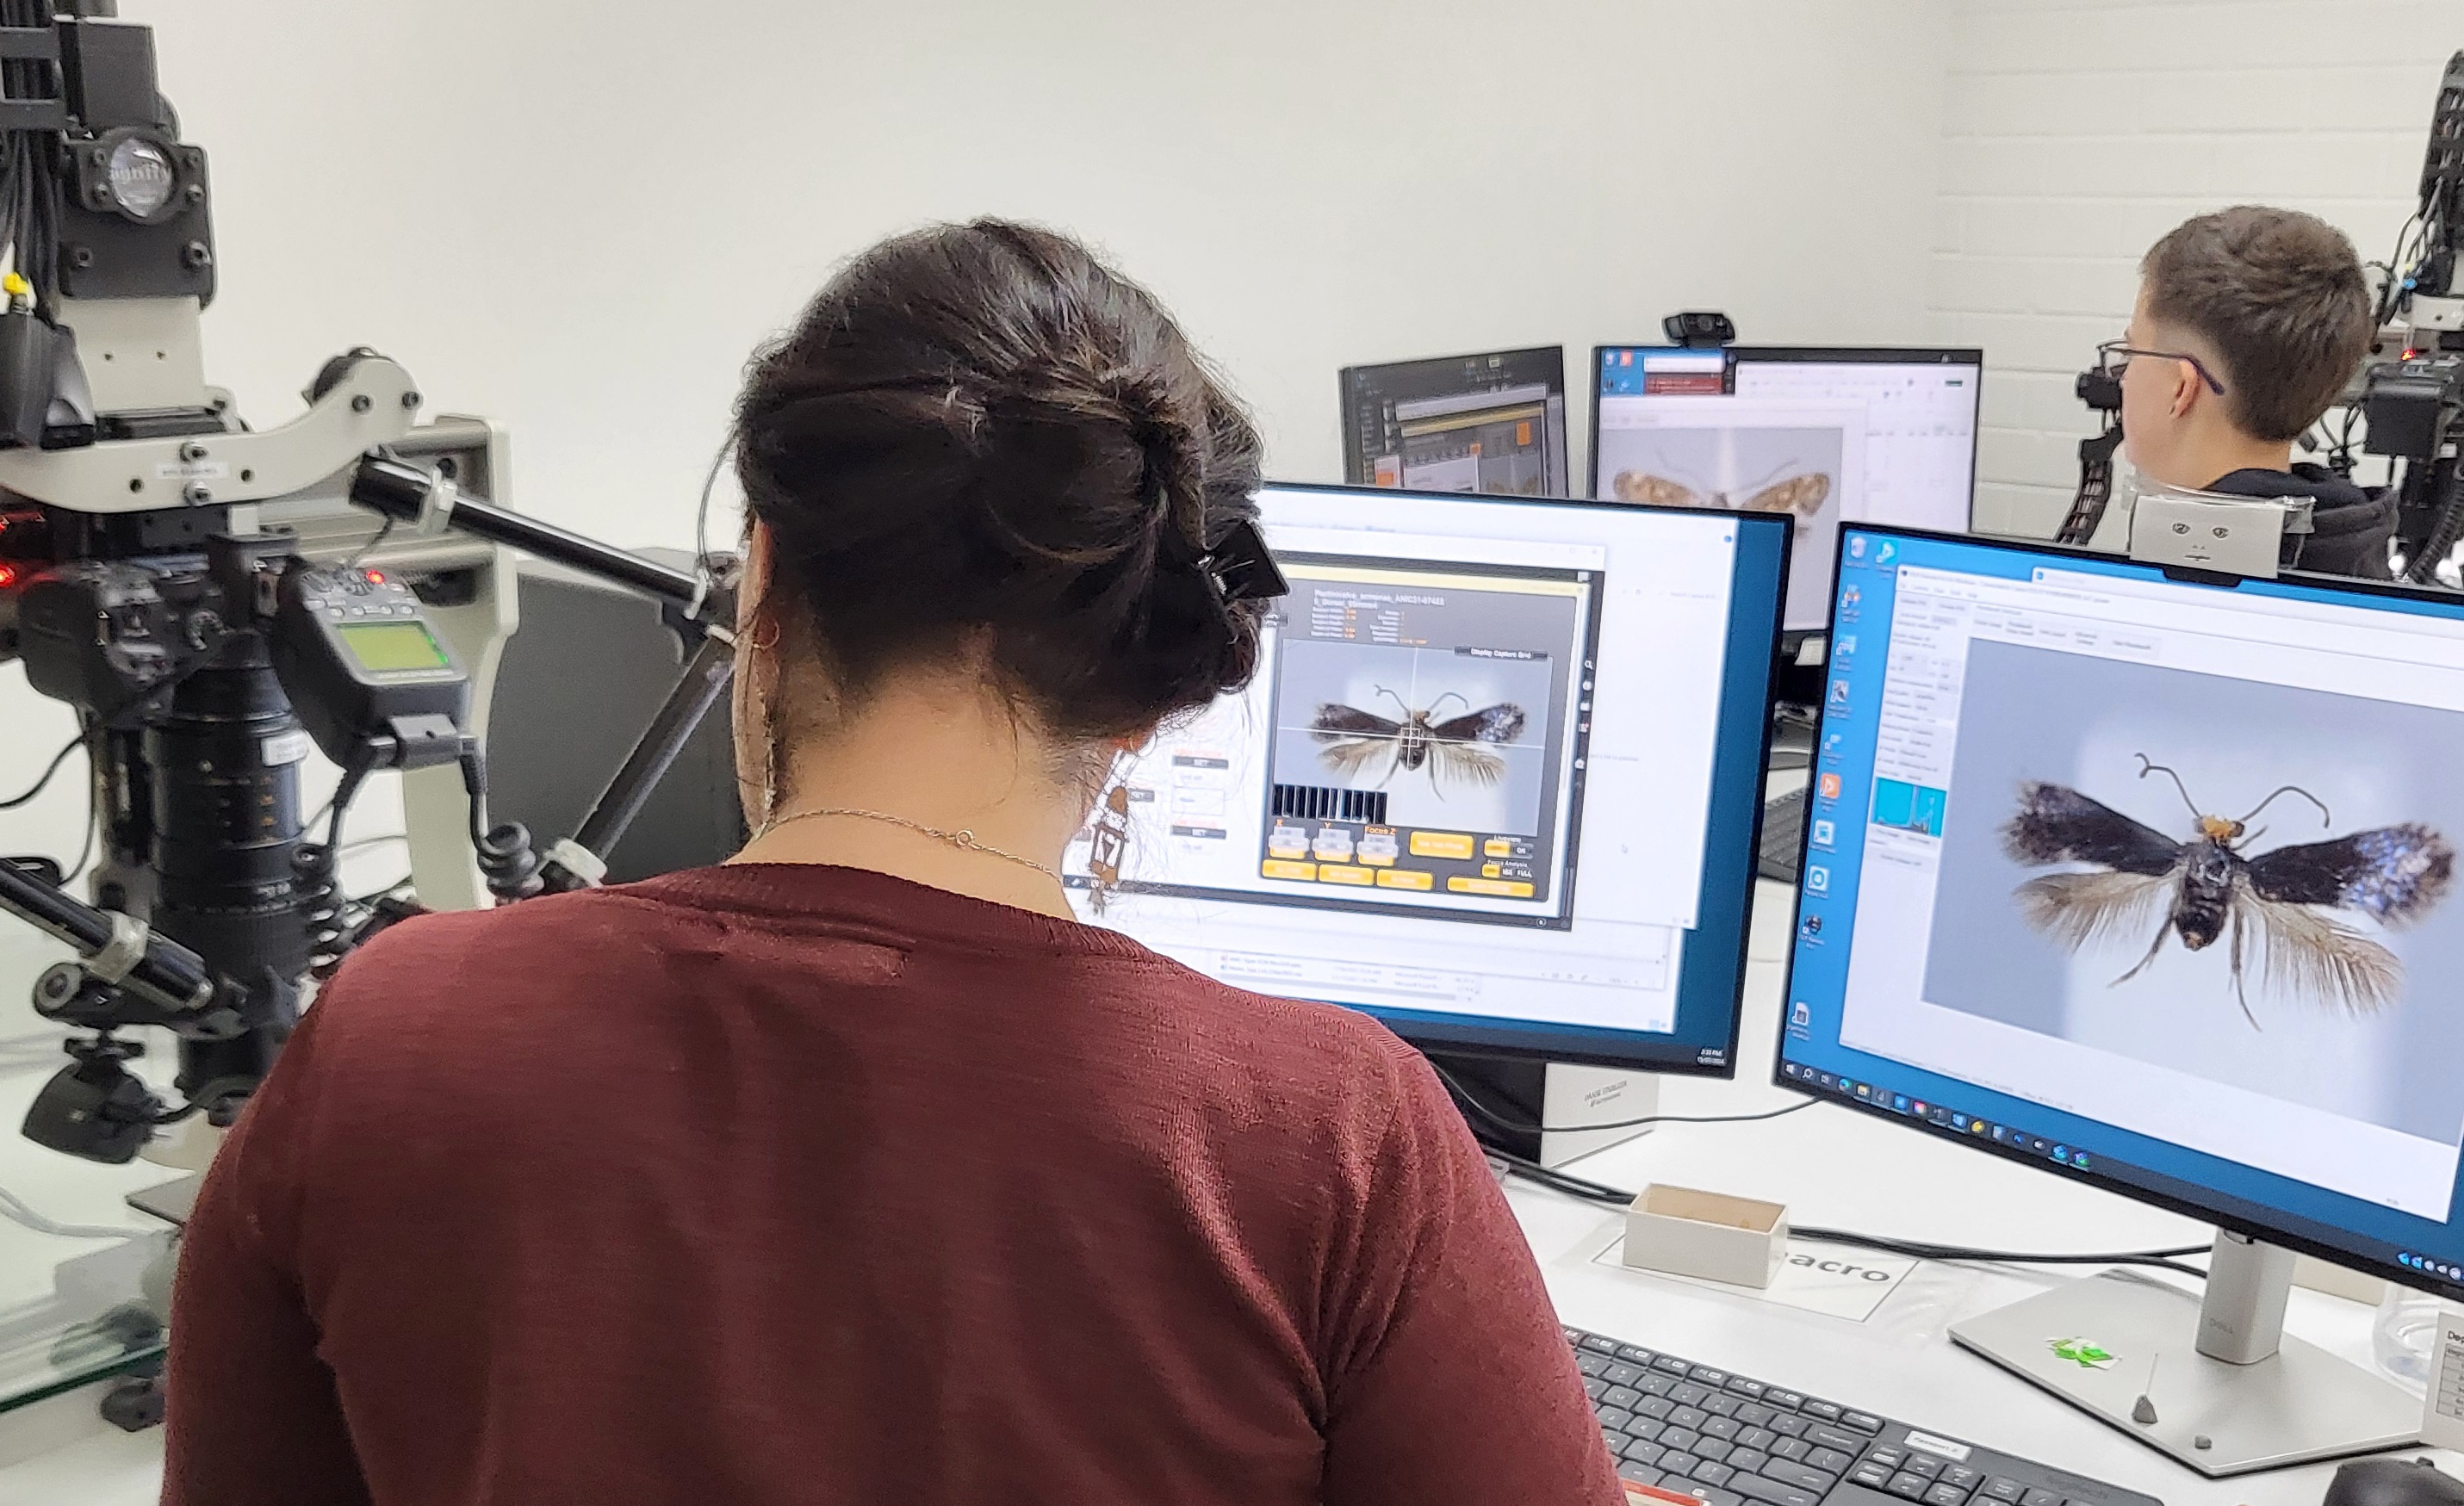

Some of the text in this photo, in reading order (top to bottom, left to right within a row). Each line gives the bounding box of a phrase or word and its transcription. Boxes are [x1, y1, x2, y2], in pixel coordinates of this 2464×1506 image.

[1365, 826, 1388, 835] Focus
[1784, 1252, 1890, 1282] acro
[2209, 1317, 2234, 1335] DELL
